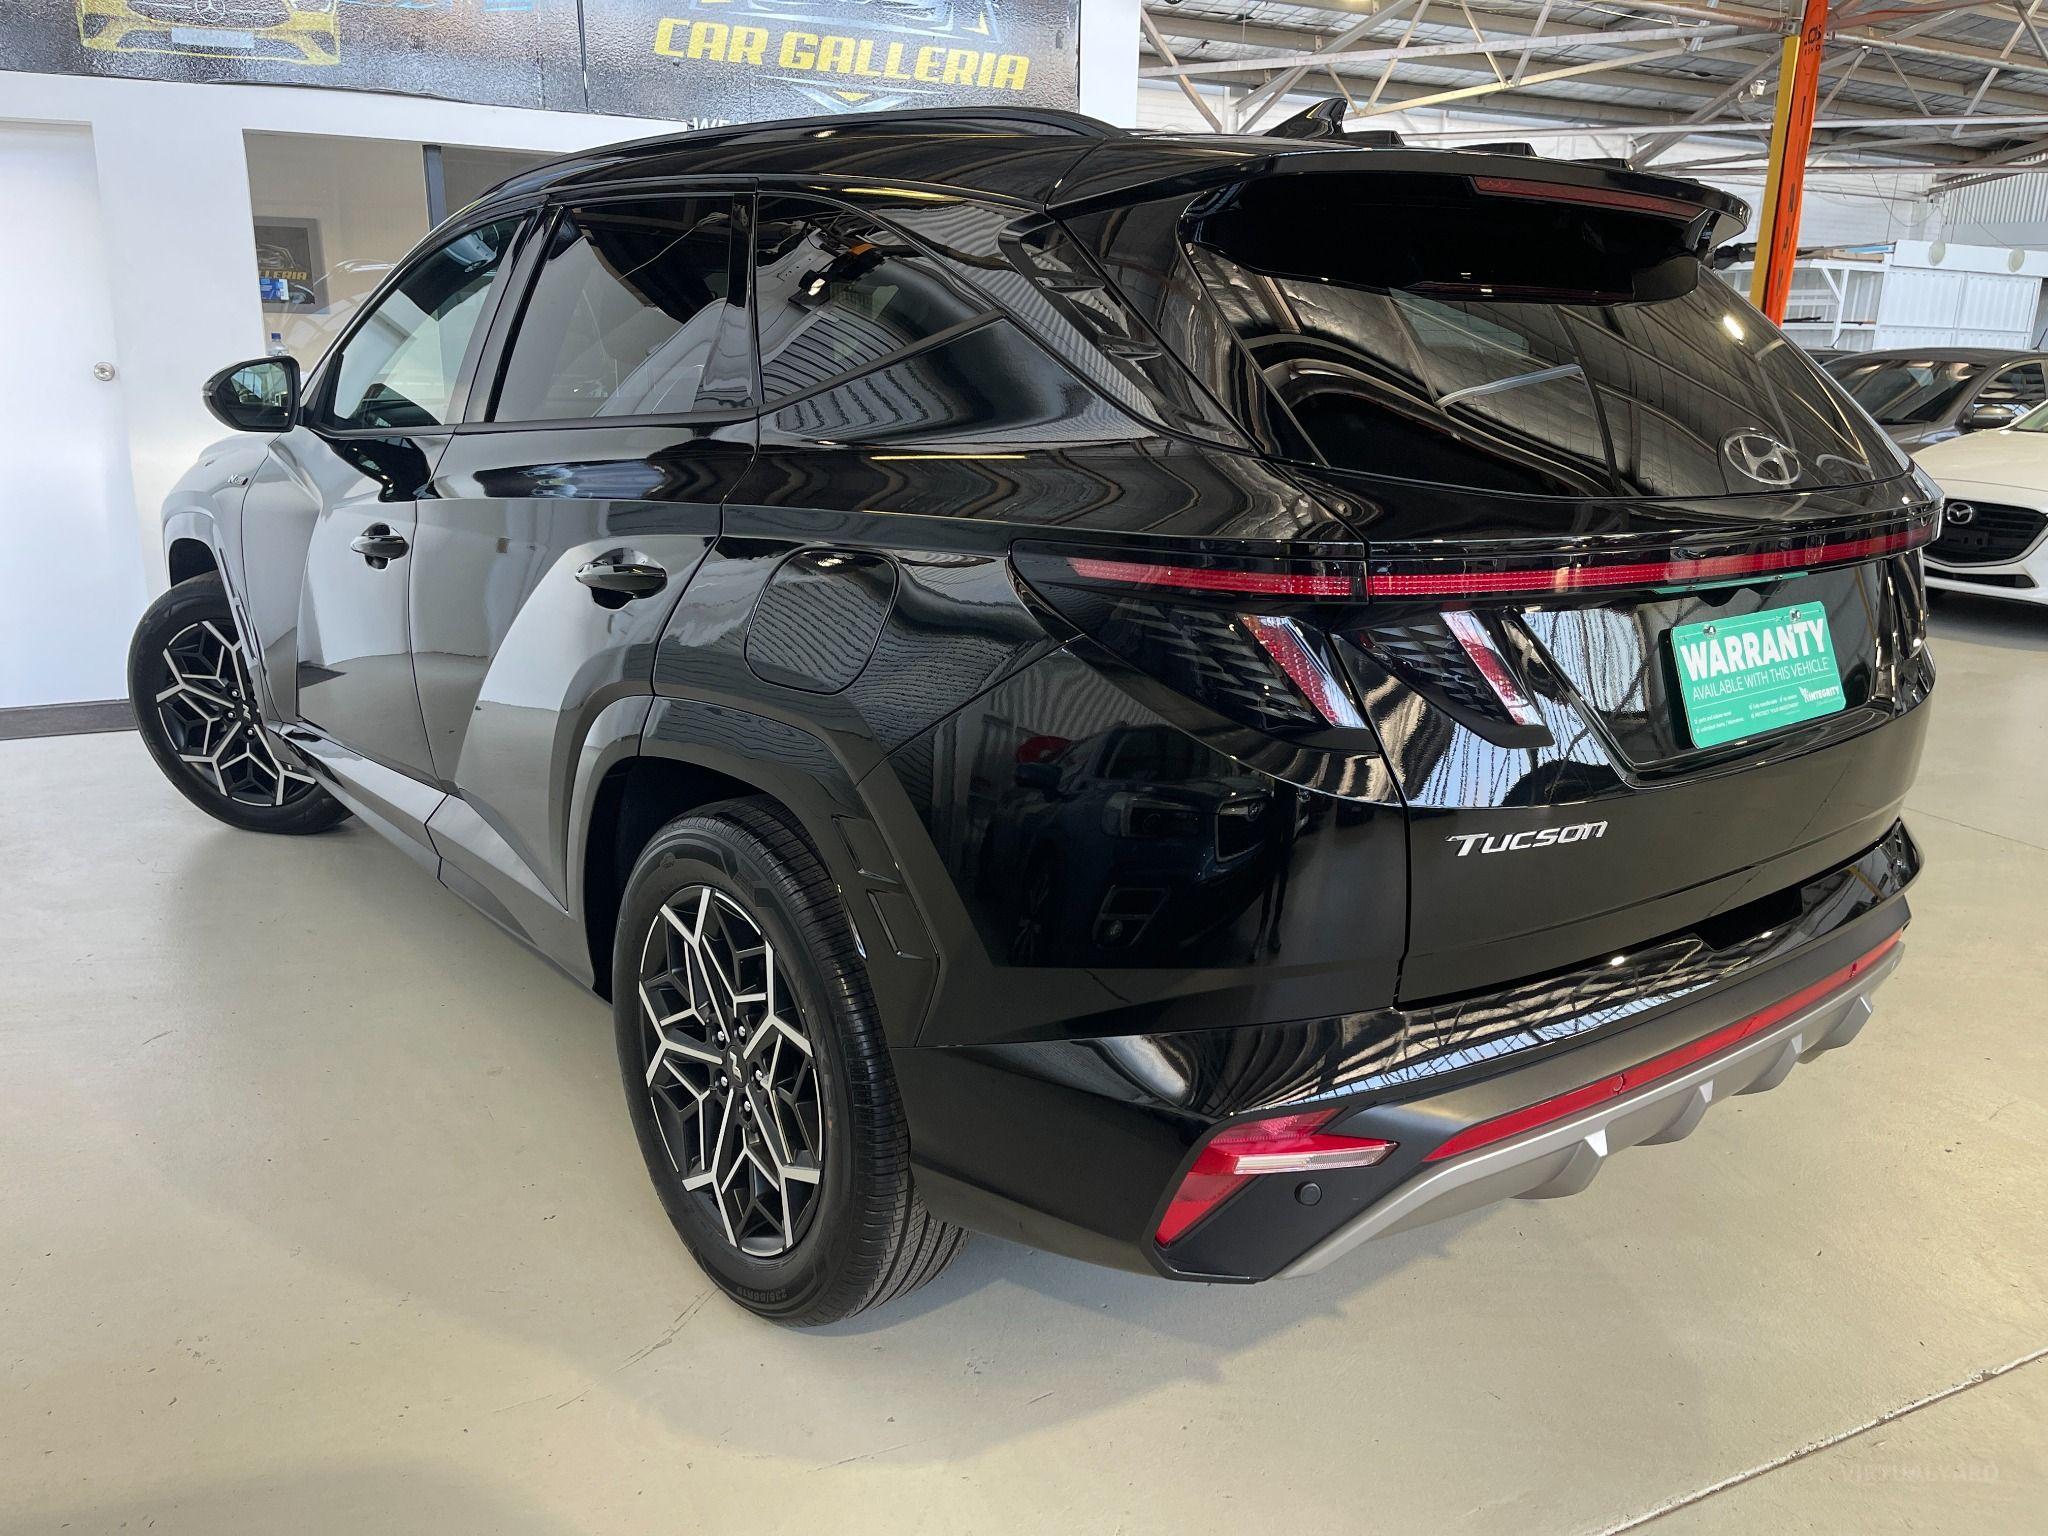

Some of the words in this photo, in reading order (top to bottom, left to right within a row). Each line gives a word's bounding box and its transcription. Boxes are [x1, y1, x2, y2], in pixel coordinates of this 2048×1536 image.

[654, 17, 769, 65] CAR
[778, 32, 1030, 90] GALLERIA
[1680, 618, 1825, 681] WARRANTY
[1693, 676, 1745, 702] AVAILABLE
[1744, 670, 1769, 688] WITH
[1770, 664, 1791, 682] THIS
[1791, 656, 1830, 678] VEHICLE
